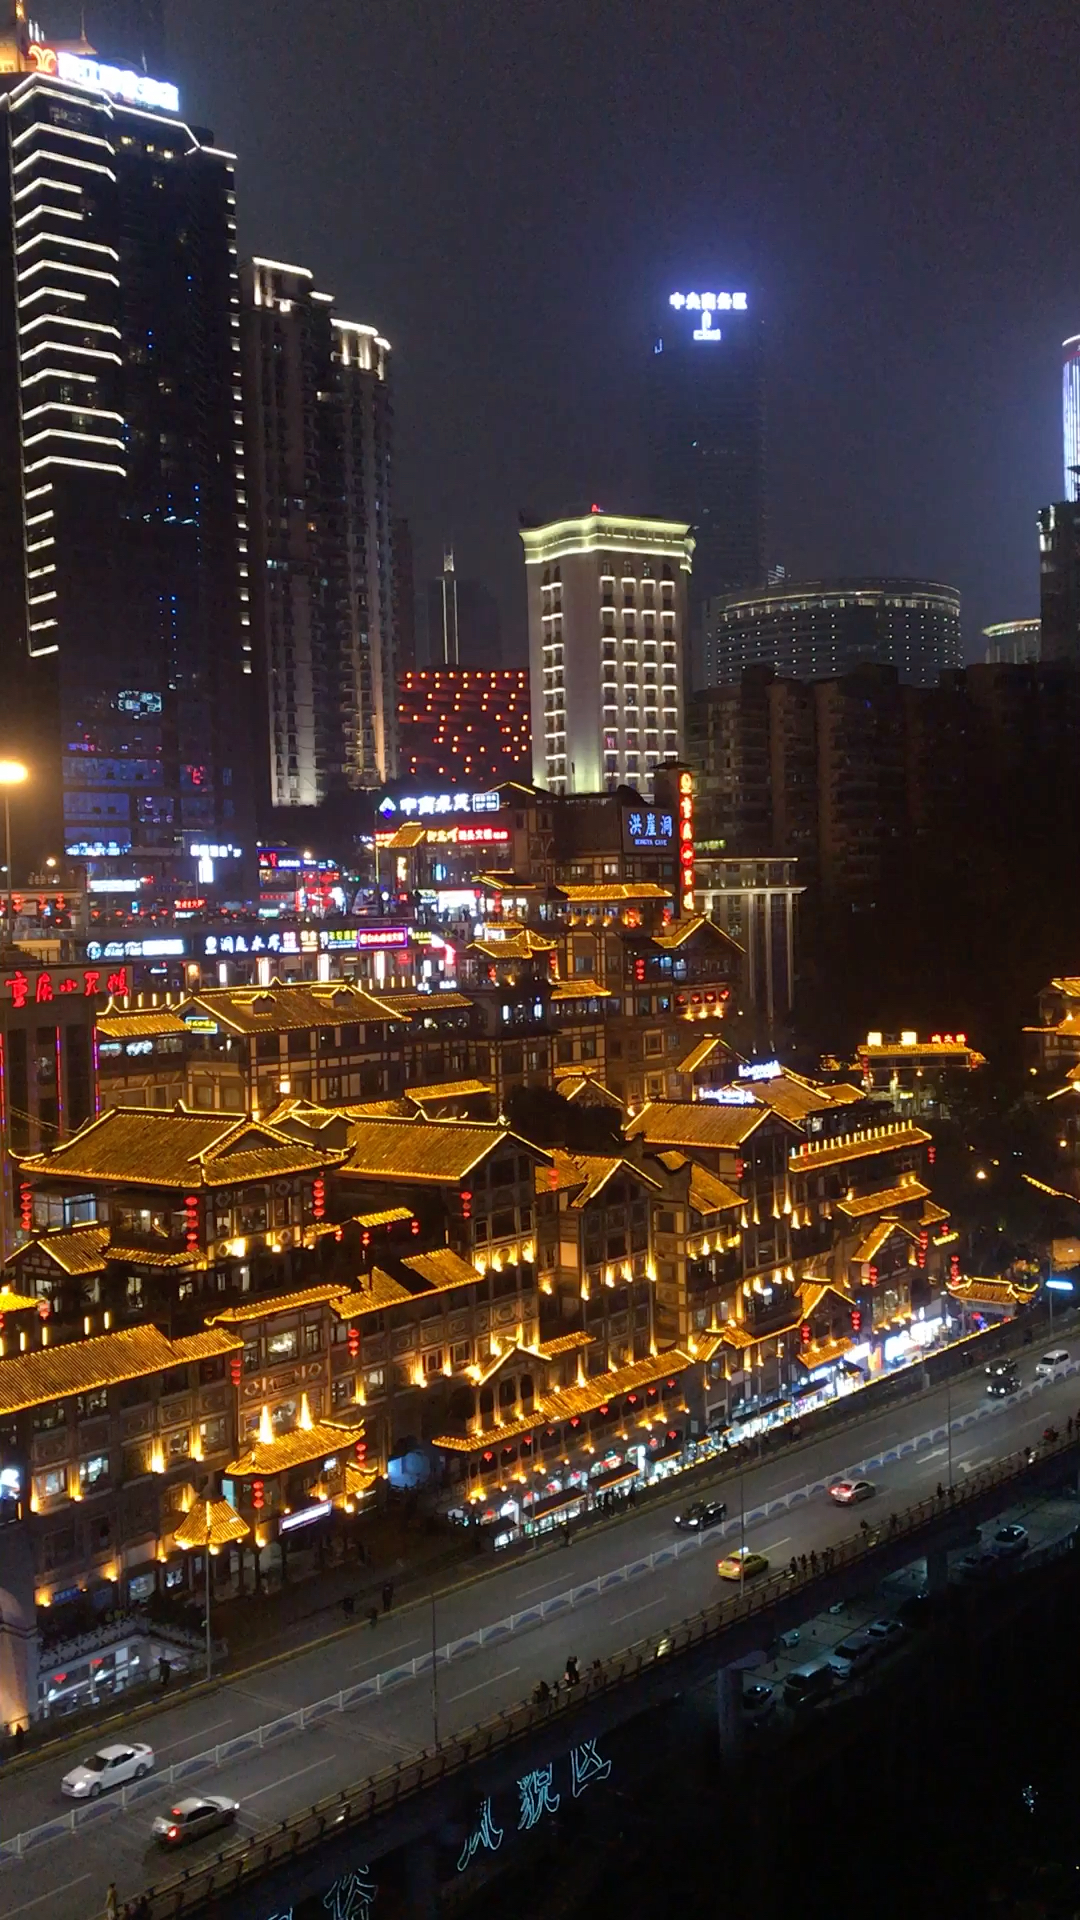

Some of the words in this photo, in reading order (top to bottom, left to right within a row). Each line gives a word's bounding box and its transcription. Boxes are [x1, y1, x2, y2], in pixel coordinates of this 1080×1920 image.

[629, 812, 673, 837] 洪崖洞
[5, 967, 129, 1008] 重庆小天鹅
